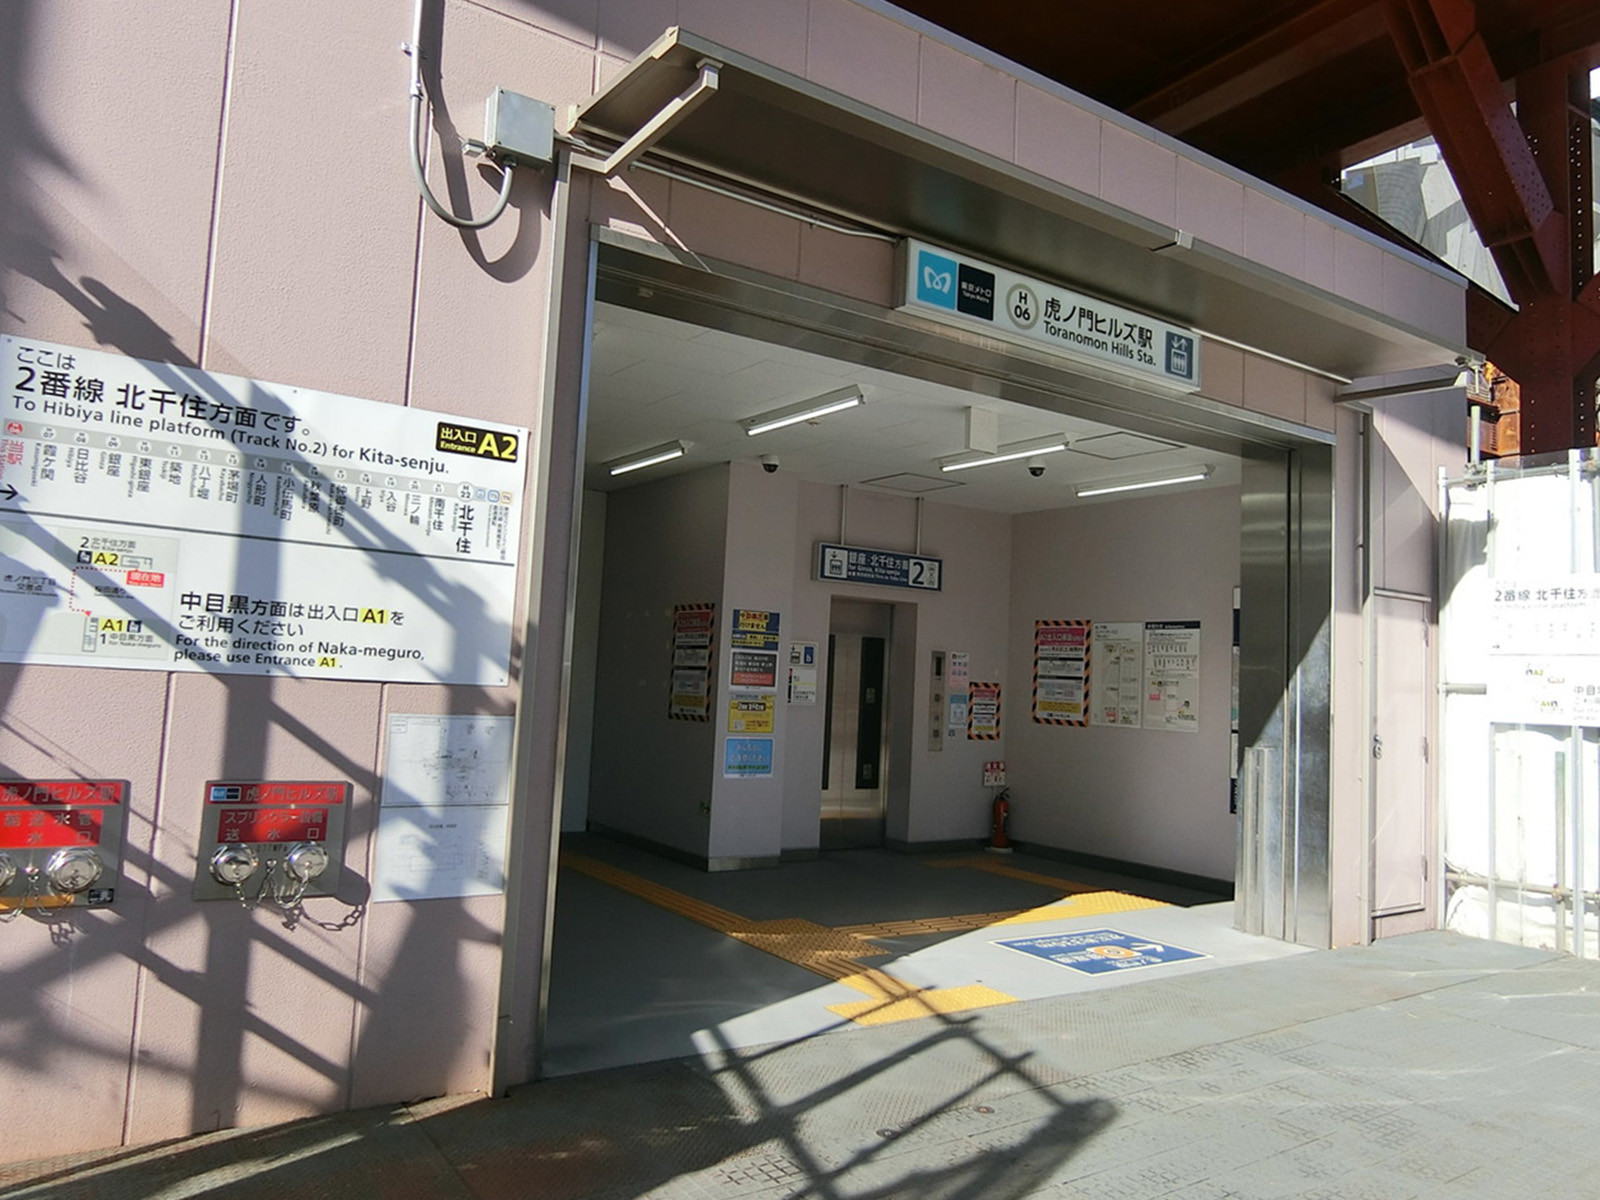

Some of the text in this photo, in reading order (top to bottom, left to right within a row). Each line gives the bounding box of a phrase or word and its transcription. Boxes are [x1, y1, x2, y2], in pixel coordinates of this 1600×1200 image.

[961, 281, 992, 297] 東京メトロ
[1018, 291, 1028, 305] H
[1014, 305, 1031, 321] 06
[1044, 297, 1153, 350] 虎ノ門ヒルズ駅
[1043, 320, 1157, 367] Toranomon Hills Sta.
[16, 346, 76, 370] ここは
[15, 366, 310, 436] 2番線 北千住方面です。
[12, 395, 449, 475] To Hibiya line platform (Track No.2) for Kita-senju.
[440, 427, 477, 444] 出入口
[440, 441, 476, 454] Entrance
[477, 432, 518, 460] A2
[74, 448, 89, 484] 日比谷
[253, 474, 267, 507] 人形町
[361, 488, 372, 509] 上野
[460, 491, 471, 499] 22
[386, 491, 397, 513] 入谷
[433, 498, 446, 531] 南千住
[456, 504, 474, 554] 北千住
[80, 536, 90, 549] 2
[94, 552, 119, 566] A2
[911, 561, 925, 585] 2
[1494, 588, 1531, 602] 2番線
[180, 591, 405, 626] 中目黒方面は出入口 A1 を
[102, 619, 124, 632] A1
[178, 614, 304, 637] ご利用ください
[100, 634, 107, 645] 1
[175, 635, 425, 661] For the direction of Naka-meguro,
[174, 649, 221, 663] please
[226, 652, 251, 664] use
[255, 654, 316, 667] Entrance
[3, 786, 115, 801] 虎ノ門ヒルズ駅
[246, 787, 338, 800] 虎ノ門ヒルズ駅
